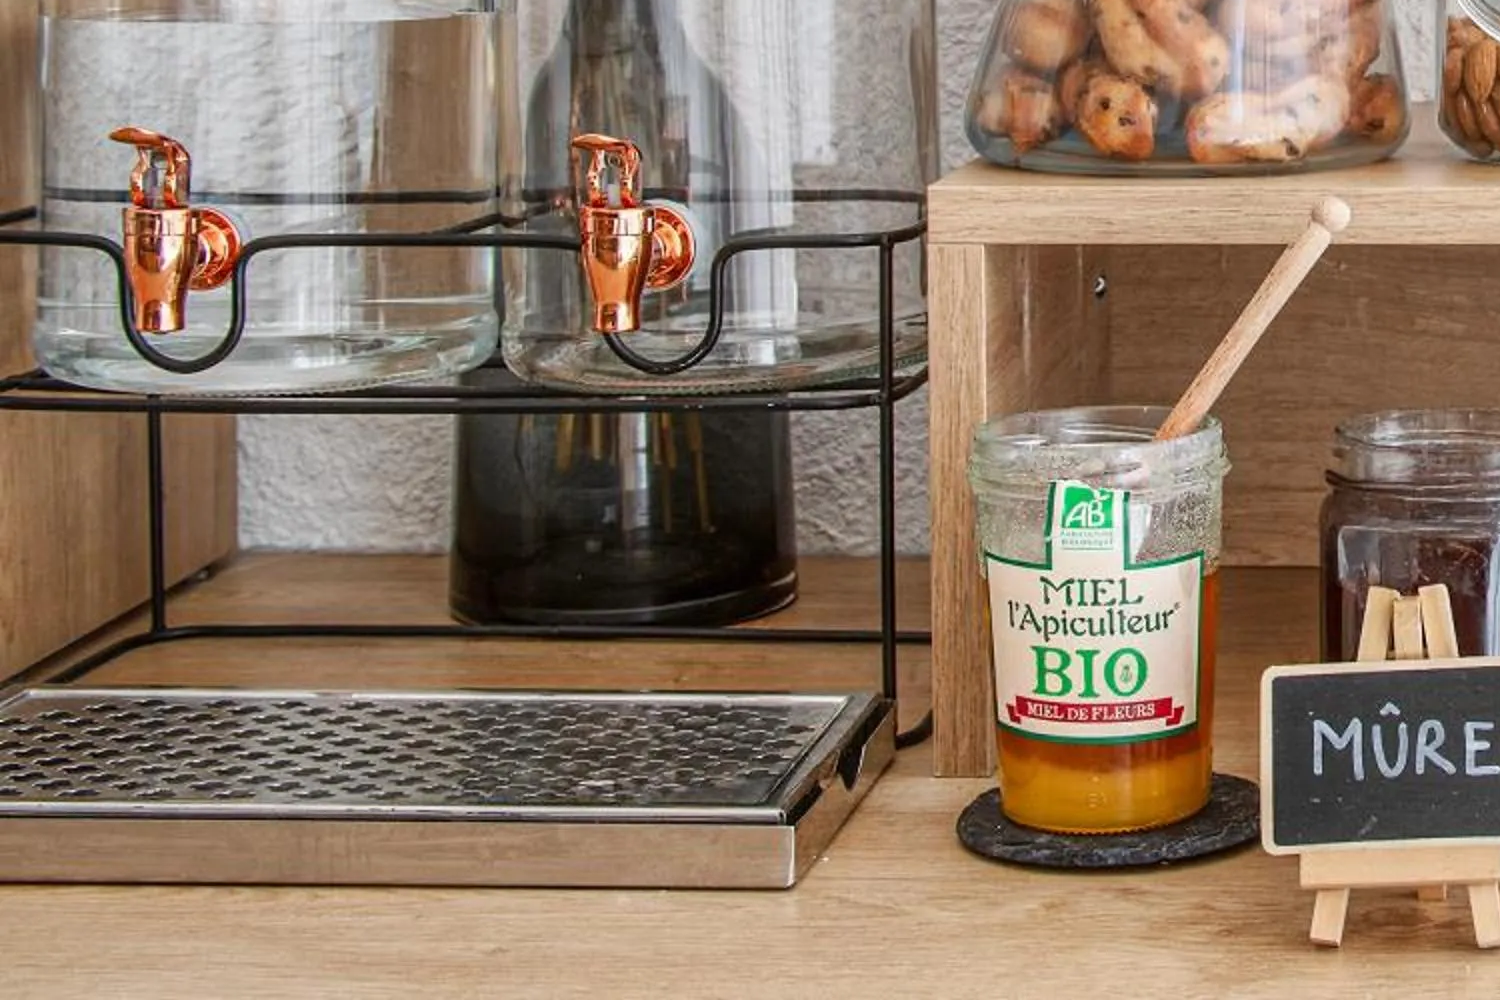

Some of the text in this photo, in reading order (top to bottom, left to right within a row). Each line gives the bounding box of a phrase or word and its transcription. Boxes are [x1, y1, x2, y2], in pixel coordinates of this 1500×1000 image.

[1065, 500, 1105, 527] AB
[1040, 576, 1144, 606] MIEL
[1030, 645, 1148, 698] BIO
[1027, 701, 1156, 720] MIEL DE FLEURS
